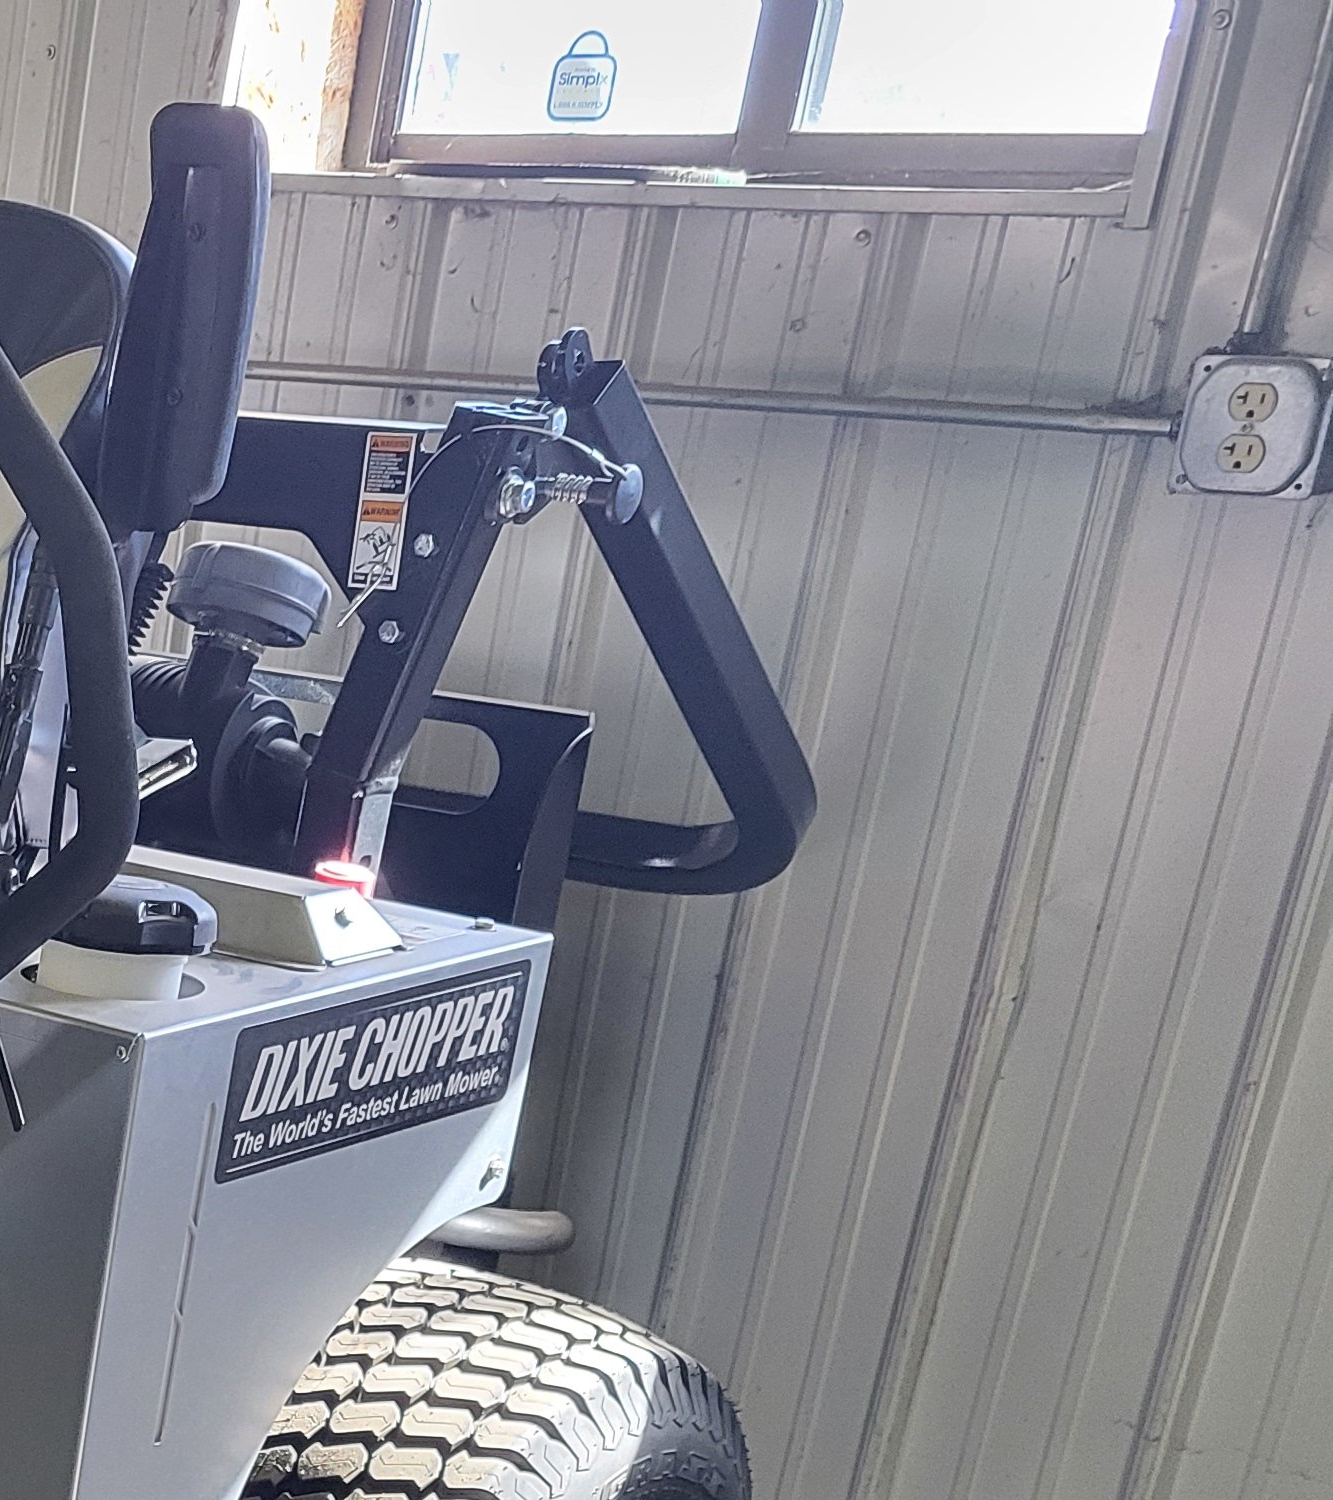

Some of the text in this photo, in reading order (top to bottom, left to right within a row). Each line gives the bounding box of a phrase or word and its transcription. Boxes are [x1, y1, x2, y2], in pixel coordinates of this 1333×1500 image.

[239, 986, 514, 1122] DIXIE CHOPPER
[232, 1132, 263, 1159] The
[268, 1109, 333, 1149] World's
[335, 1095, 398, 1129] Fastest
[400, 1080, 442, 1111] Lawn
